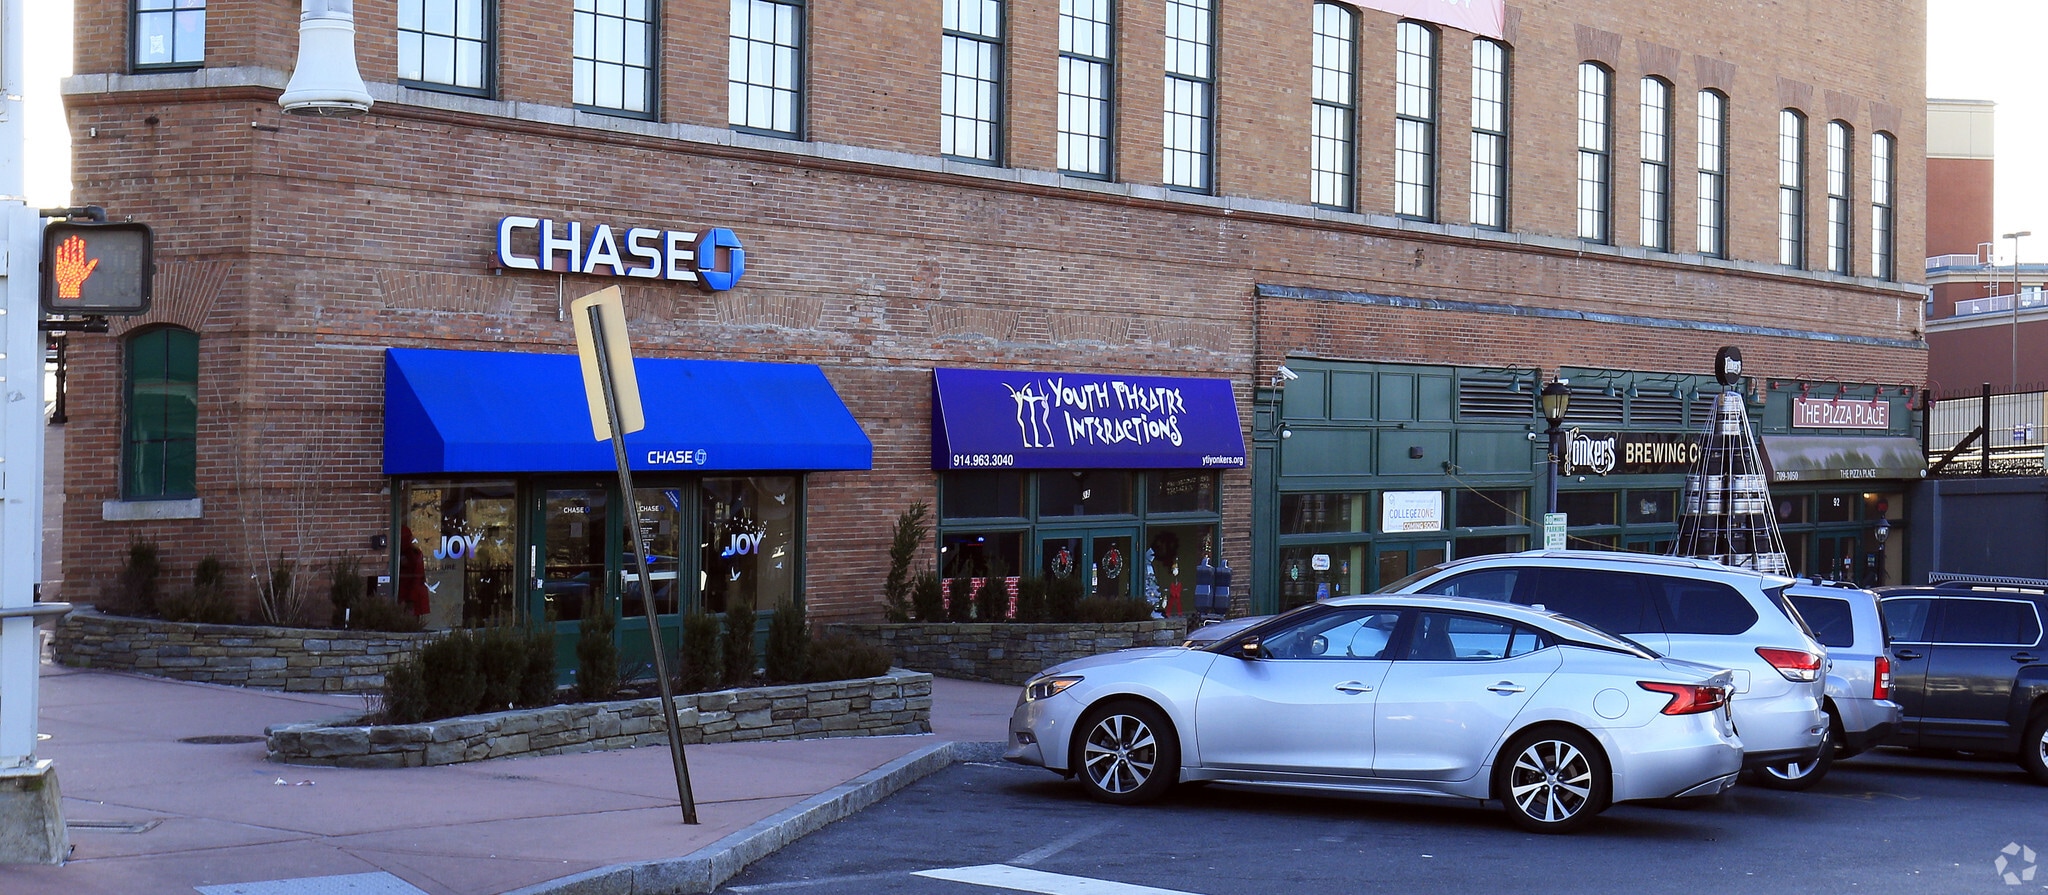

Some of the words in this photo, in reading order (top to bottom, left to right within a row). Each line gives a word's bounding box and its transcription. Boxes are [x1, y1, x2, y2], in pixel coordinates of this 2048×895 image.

[497, 215, 699, 282] CHASE
[1047, 377, 1110, 413] YOUTH
[1111, 380, 1188, 415] THEATRE
[1798, 402, 1820, 424] THE
[1823, 403, 1853, 424] PIZZA
[1855, 404, 1885, 425] PLACE
[1063, 410, 1183, 447] INTERACTIONS
[1564, 426, 1617, 476] Yonkers
[1625, 442, 1687, 464] BREWING
[647, 451, 694, 464] CHASE
[953, 454, 1014, 466] 914.963.3040
[1202, 454, 1244, 466] ytiyonkers.org
[1840, 469, 1849, 479] THE
[1849, 469, 1862, 478] PIZZA
[1862, 469, 1876, 478] PLACE
[1833, 497, 1840, 507] 92
[563, 506, 585, 514] CHASE
[1389, 508, 1435, 519] COLLEGEZONE
[1403, 522, 1423, 530] COMING
[1424, 521, 1439, 529] SOON
[1546, 525, 1565, 533] PARKING
[433, 535, 481, 560] JOY
[724, 533, 763, 556] JOY
